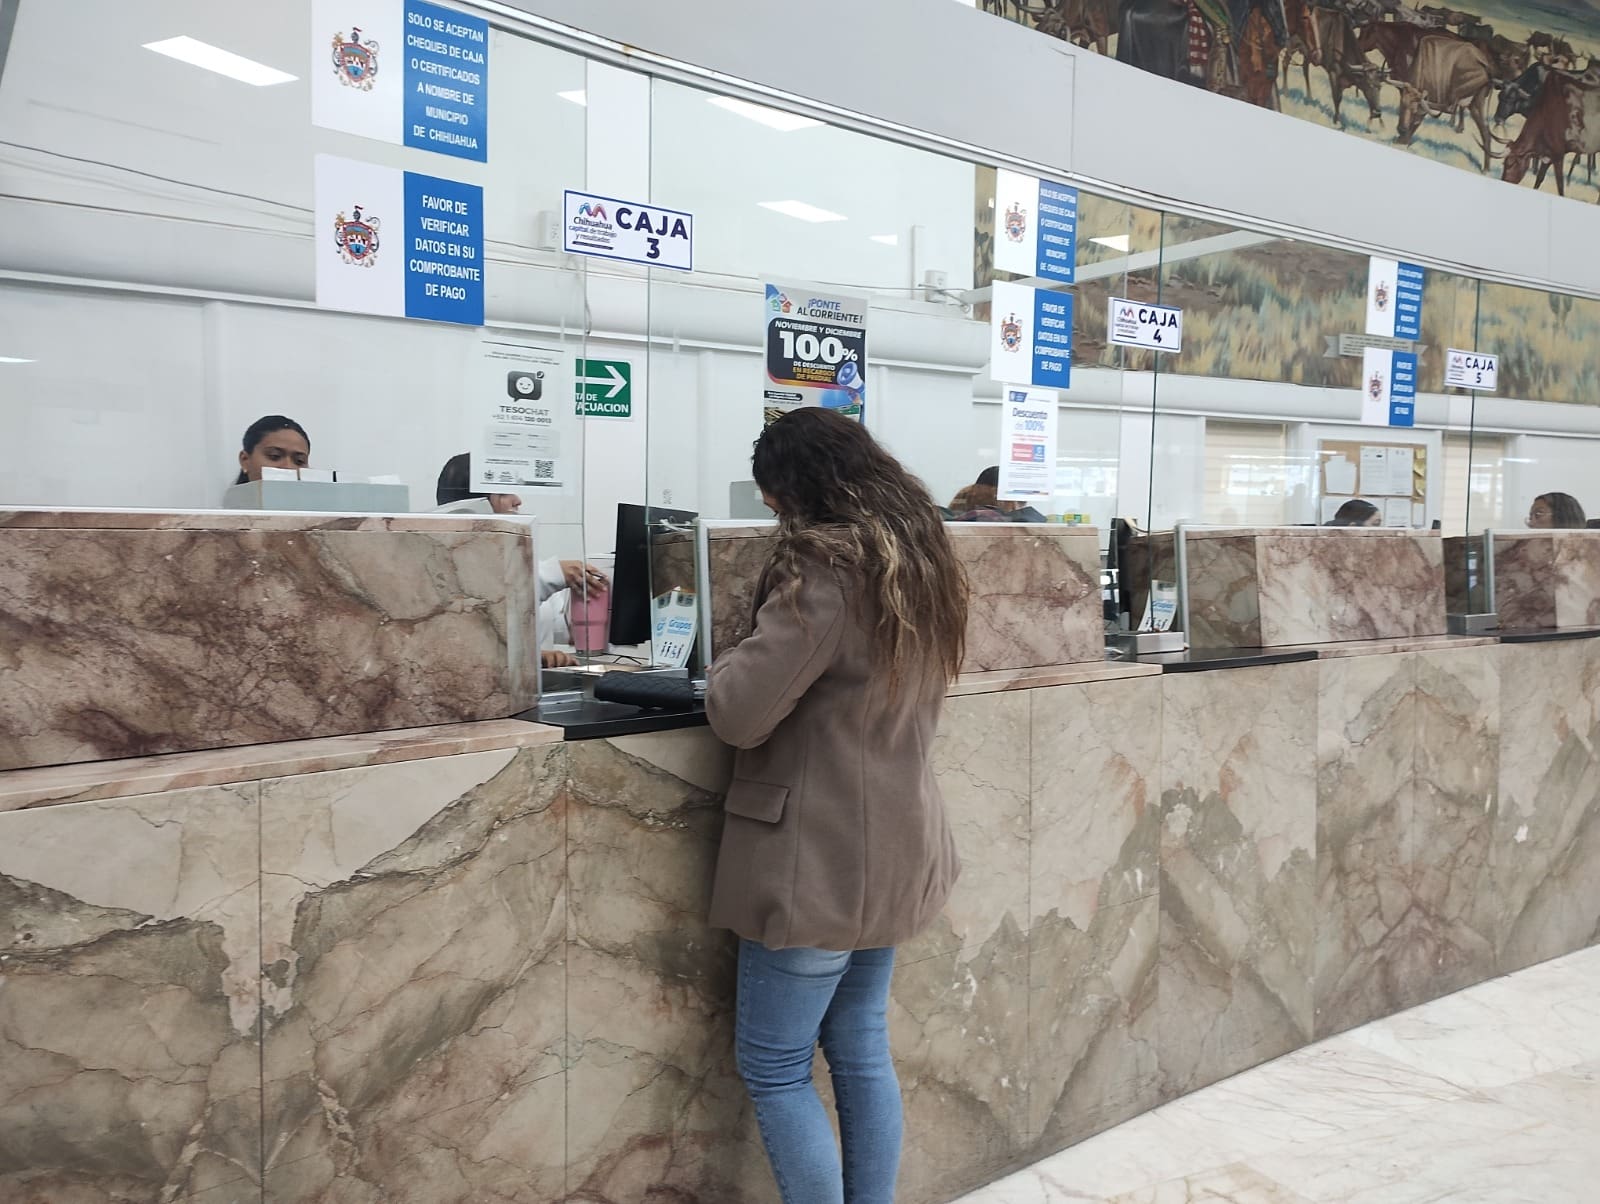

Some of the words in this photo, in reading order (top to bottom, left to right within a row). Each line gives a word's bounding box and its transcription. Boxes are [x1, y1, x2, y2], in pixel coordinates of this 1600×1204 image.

[408, 12, 432, 28] SOLO
[433, 19, 444, 32] SE
[446, 23, 483, 42] ACEPTAN
[408, 34, 448, 55] CHEQUES
[449, 46, 461, 58] DE
[462, 50, 484, 64] CAJA
[412, 58, 418, 69] O
[420, 60, 480, 85] CERTIFICADOS
[417, 82, 424, 93] A
[425, 84, 461, 102] NOMBRE
[463, 94, 474, 105] DE
[426, 106, 468, 125] MUNICIPIO
[414, 125, 425, 137] DE
[429, 129, 478, 149] CHIHUAHUA
[422, 195, 452, 212] FAVOR
[455, 202, 468, 215] DE
[420, 217, 470, 237] VERIFICAR
[574, 216, 612, 230] Chihuahua
[616, 207, 688, 240] CAJA
[415, 238, 446, 254] DATOS
[448, 244, 460, 257] EN
[463, 246, 474, 259] SU
[646, 238, 660, 259] 3
[410, 259, 480, 281] COMPROBANTE
[426, 283, 439, 296] DE
[440, 285, 466, 300] PAGO
[808, 298, 840, 310] ¡PONTE
[797, 307, 808, 316] AL
[810, 308, 863, 324] CORRIENTE!
[1138, 309, 1177, 328] CAJA
[775, 321, 817, 333] NOVIEMBRE
[825, 328, 862, 338] DICIEMBRE
[1153, 329, 1162, 343] 4
[780, 331, 858, 364] 100%
[803, 361, 835, 370] DESCUENTO
[1466, 357, 1494, 371] CAJA
[1476, 372, 1482, 383] 5
[499, 405, 550, 416] TESOCHAT
[576, 402, 629, 413] ACUACION
[1012, 408, 1047, 419] Descuento
